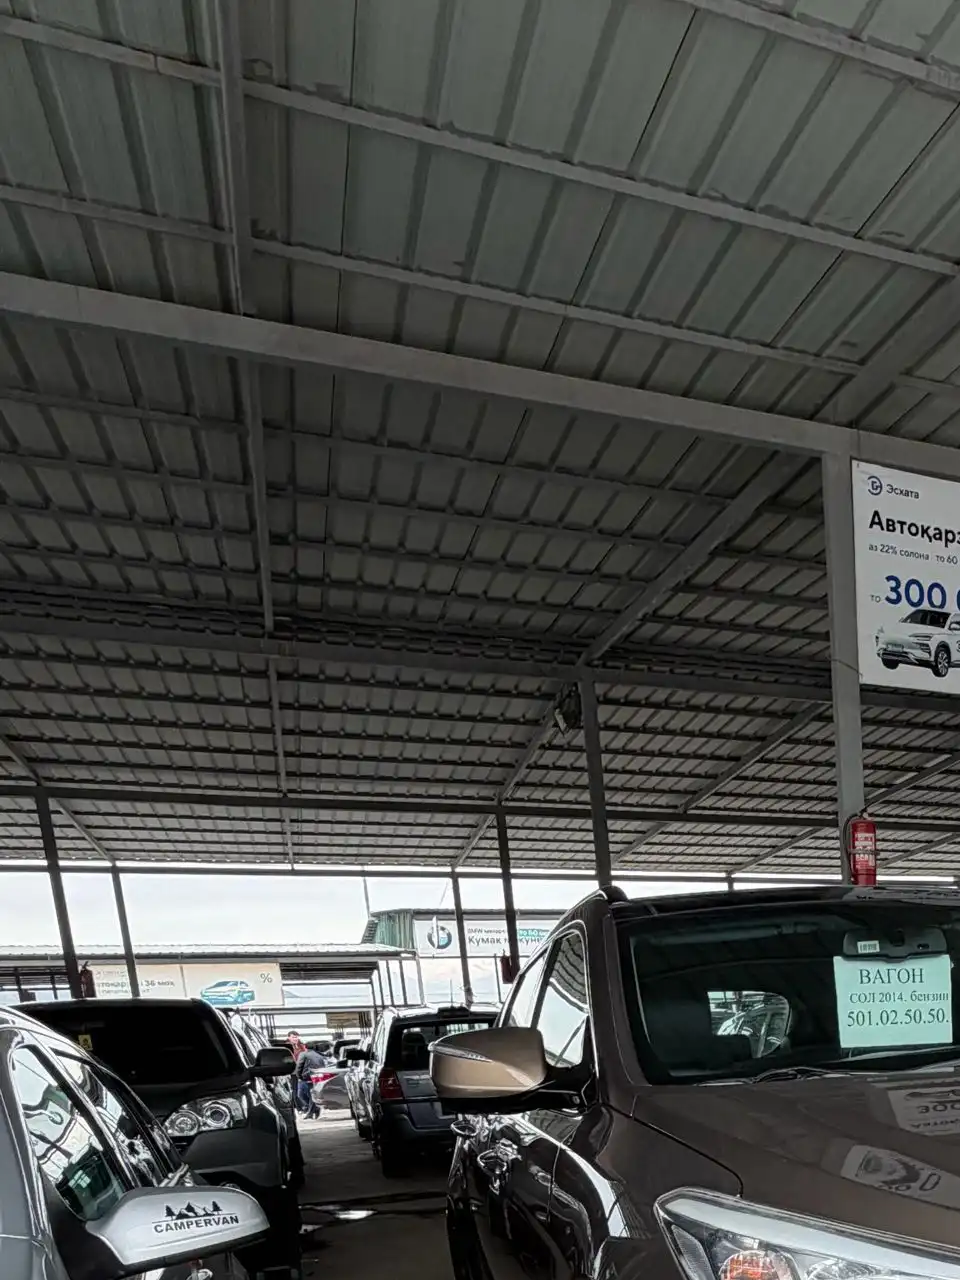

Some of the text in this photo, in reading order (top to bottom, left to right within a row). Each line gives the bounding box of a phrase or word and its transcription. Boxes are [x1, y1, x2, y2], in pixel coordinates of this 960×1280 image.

[886, 483, 920, 500] Эсхата
[868, 543, 878, 552] аз
[879, 543, 898, 556] 22%
[899, 549, 930, 561] солона
[935, 555, 945, 563] то
[946, 554, 958, 565] 60
[870, 593, 881, 604] то
[884, 574, 947, 610] 300
[260, 973, 273, 984] %
[859, 968, 924, 984] ВАГОН
[849, 992, 876, 1004] СОЛ
[910, 990, 949, 1003] бензин
[847, 1007, 950, 1028] 501.02.50.50.
[154, 1215, 239, 1233] CAMPERVAN
